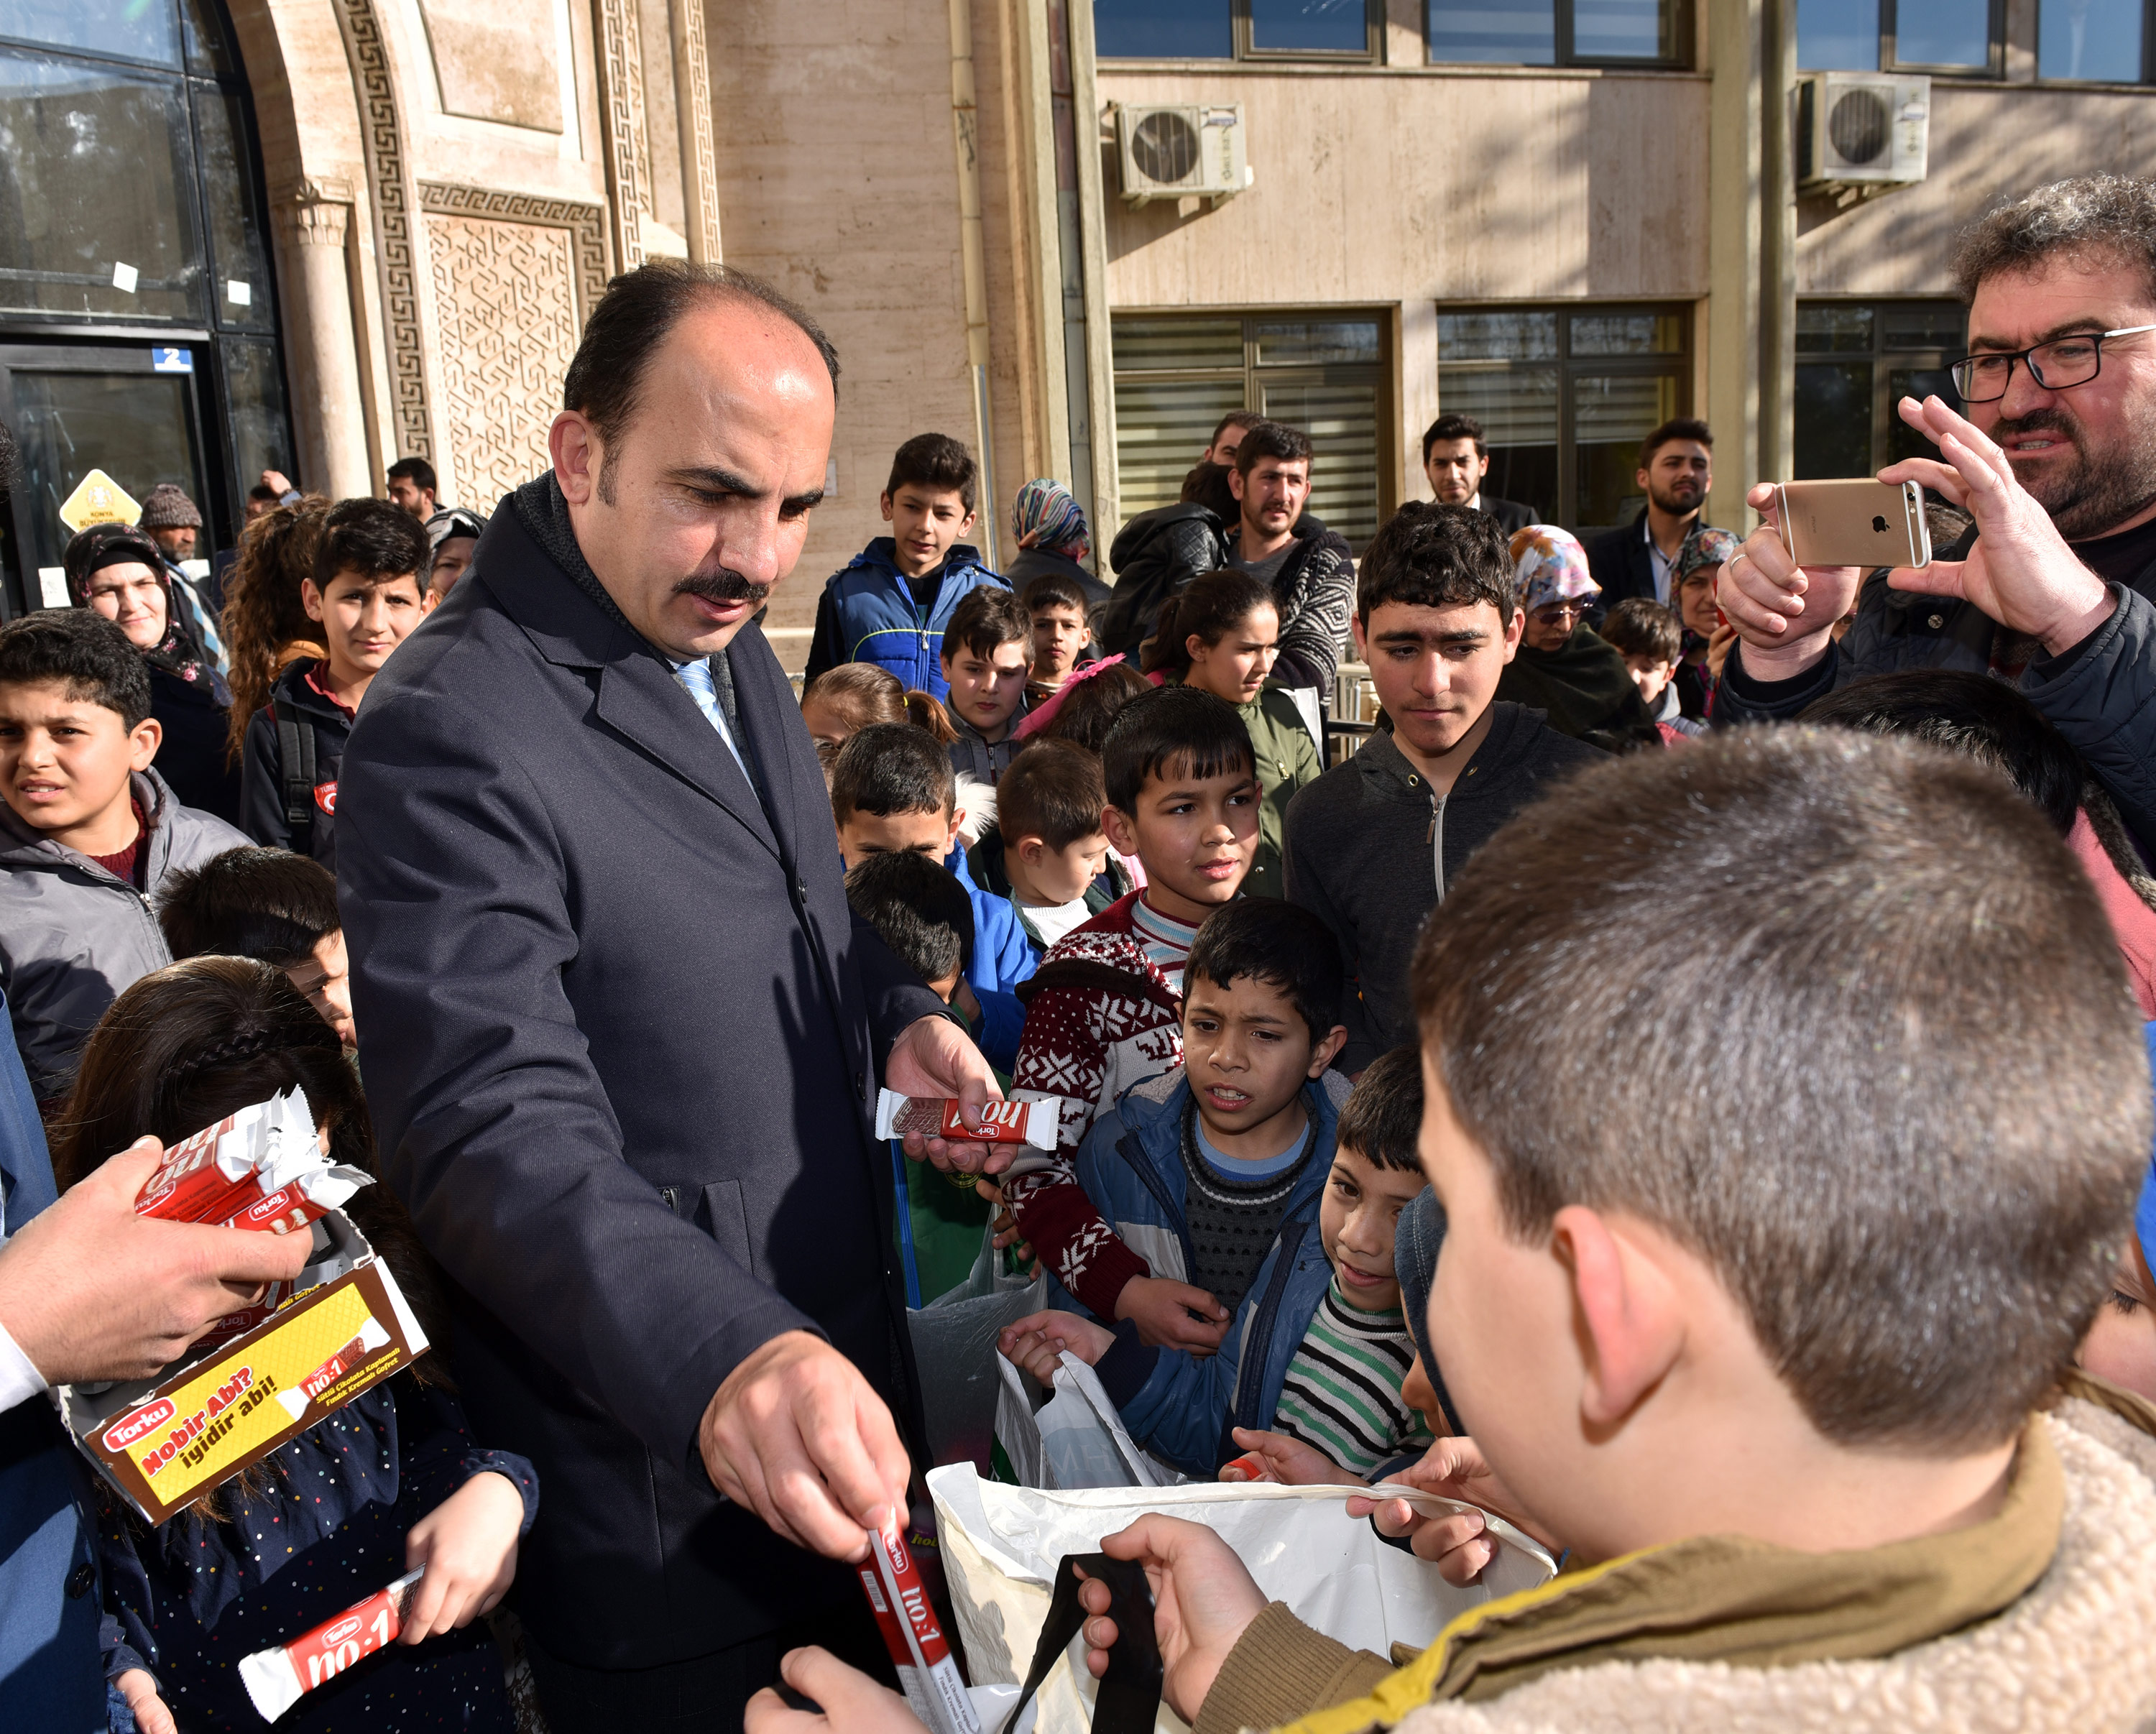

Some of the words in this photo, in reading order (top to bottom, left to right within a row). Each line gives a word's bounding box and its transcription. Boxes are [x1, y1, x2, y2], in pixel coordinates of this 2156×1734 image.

[163, 348, 181, 364] 2
[973, 1127, 995, 1135] Tork
[253, 1194, 285, 1215] Torku
[216, 1317, 246, 1329] Tork
[307, 1359, 342, 1397] no:1
[316, 1387, 336, 1403] Sütlü
[336, 1370, 365, 1391] Çikolata
[365, 1347, 400, 1373] Kaplamalı
[326, 1389, 348, 1406] Fındık
[348, 1373, 375, 1392] Kremalı
[376, 1357, 399, 1375] Gofret
[110, 1405, 169, 1444] Torku
[141, 1410, 207, 1477] Nobir
[206, 1366, 254, 1419] Abi?
[179, 1413, 234, 1469] iyidir
[239, 1375, 277, 1417] abi!
[910, 1533, 938, 1547] hob
[901, 1586, 940, 1643] no:1
[307, 1608, 389, 1689] no:1
